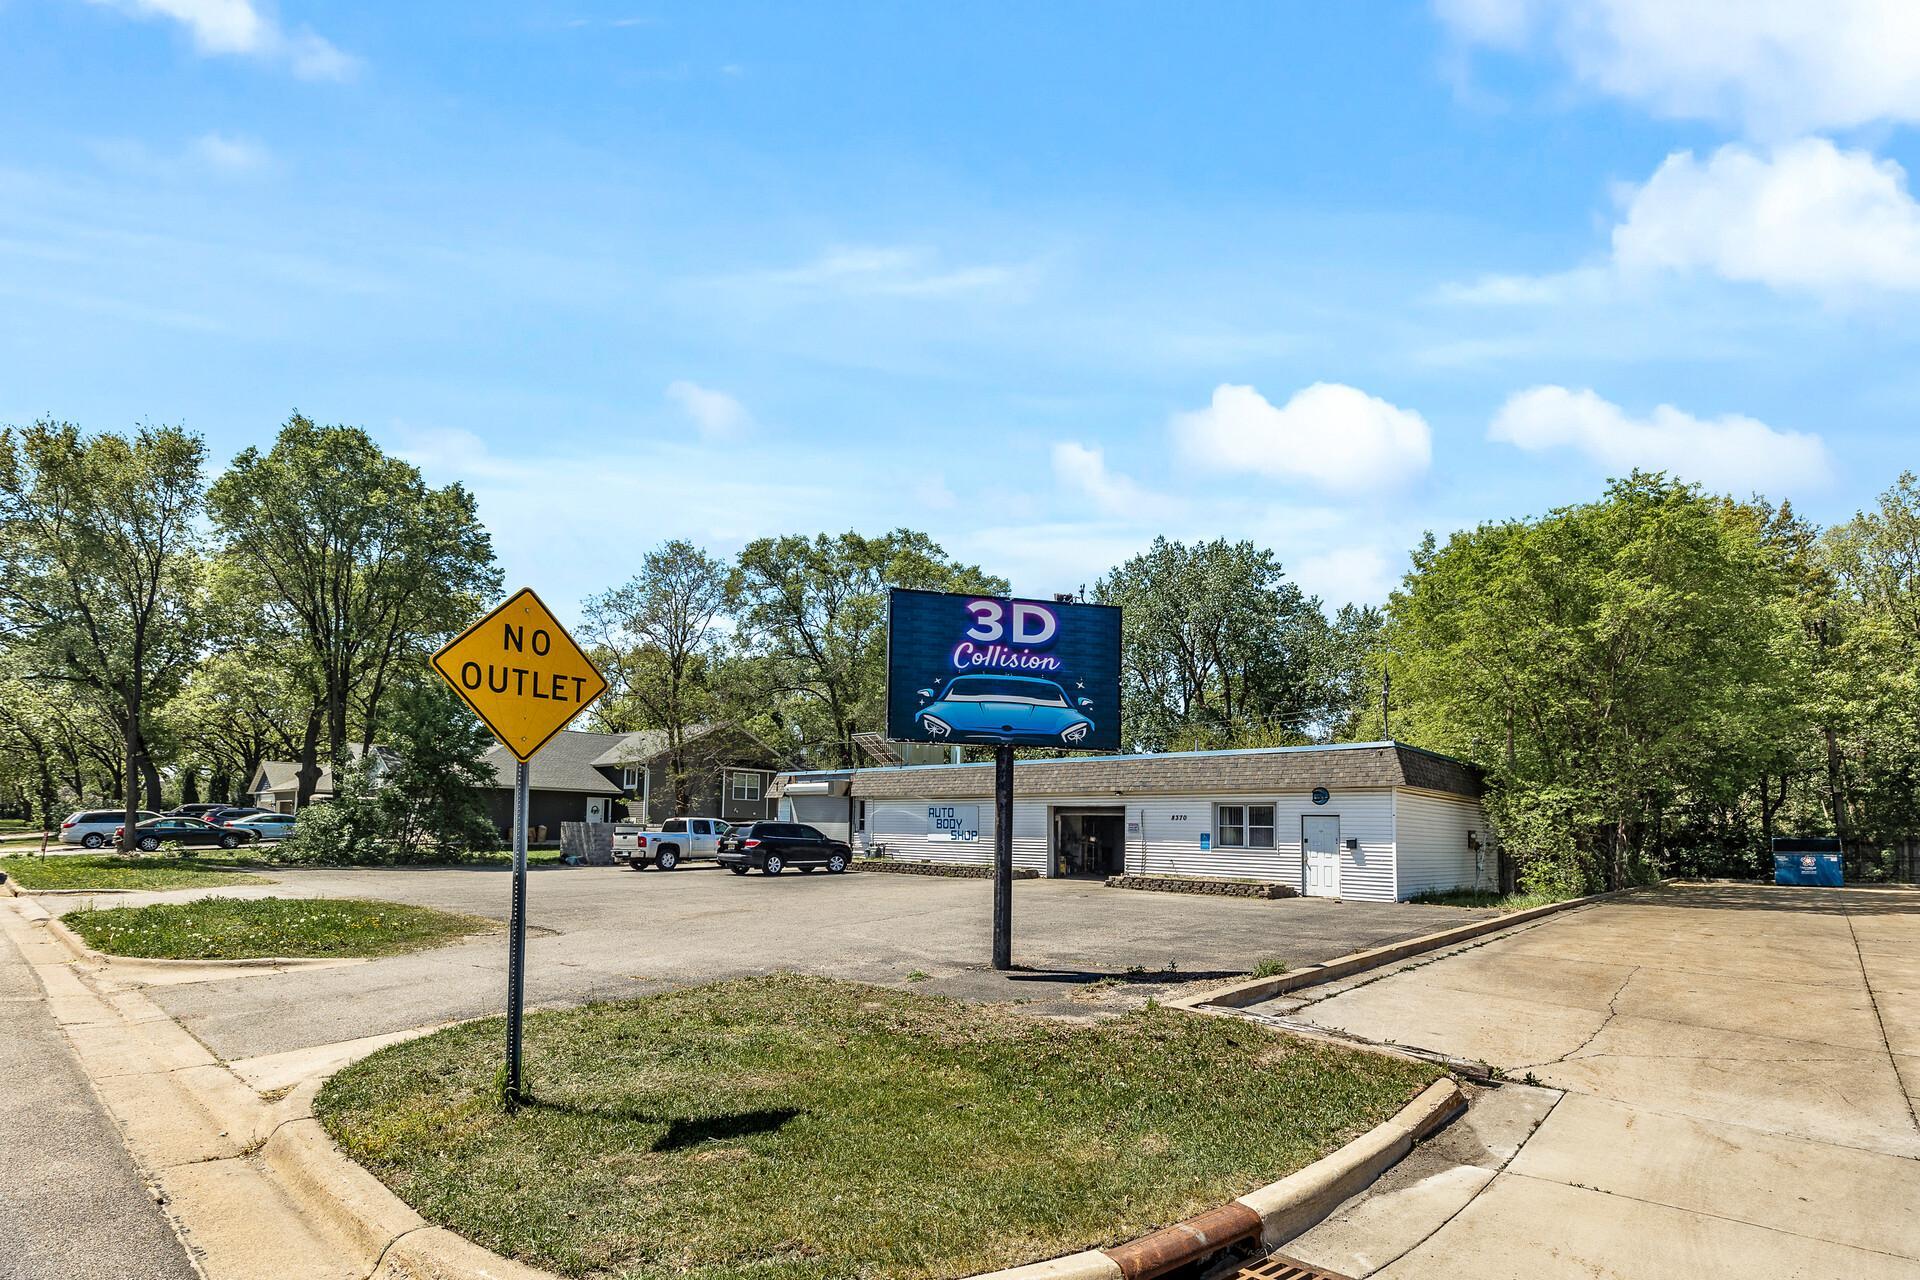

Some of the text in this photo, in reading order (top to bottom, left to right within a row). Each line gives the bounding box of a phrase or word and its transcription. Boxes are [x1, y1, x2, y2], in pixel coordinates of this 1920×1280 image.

[966, 600, 1057, 644] 3D
[504, 623, 551, 657] NO
[953, 642, 1061, 671] Collision
[461, 661, 587, 703] OUTLET
[928, 807, 955, 818] AUTO
[936, 818, 963, 829] BODY
[950, 829, 978, 841] SHOP
